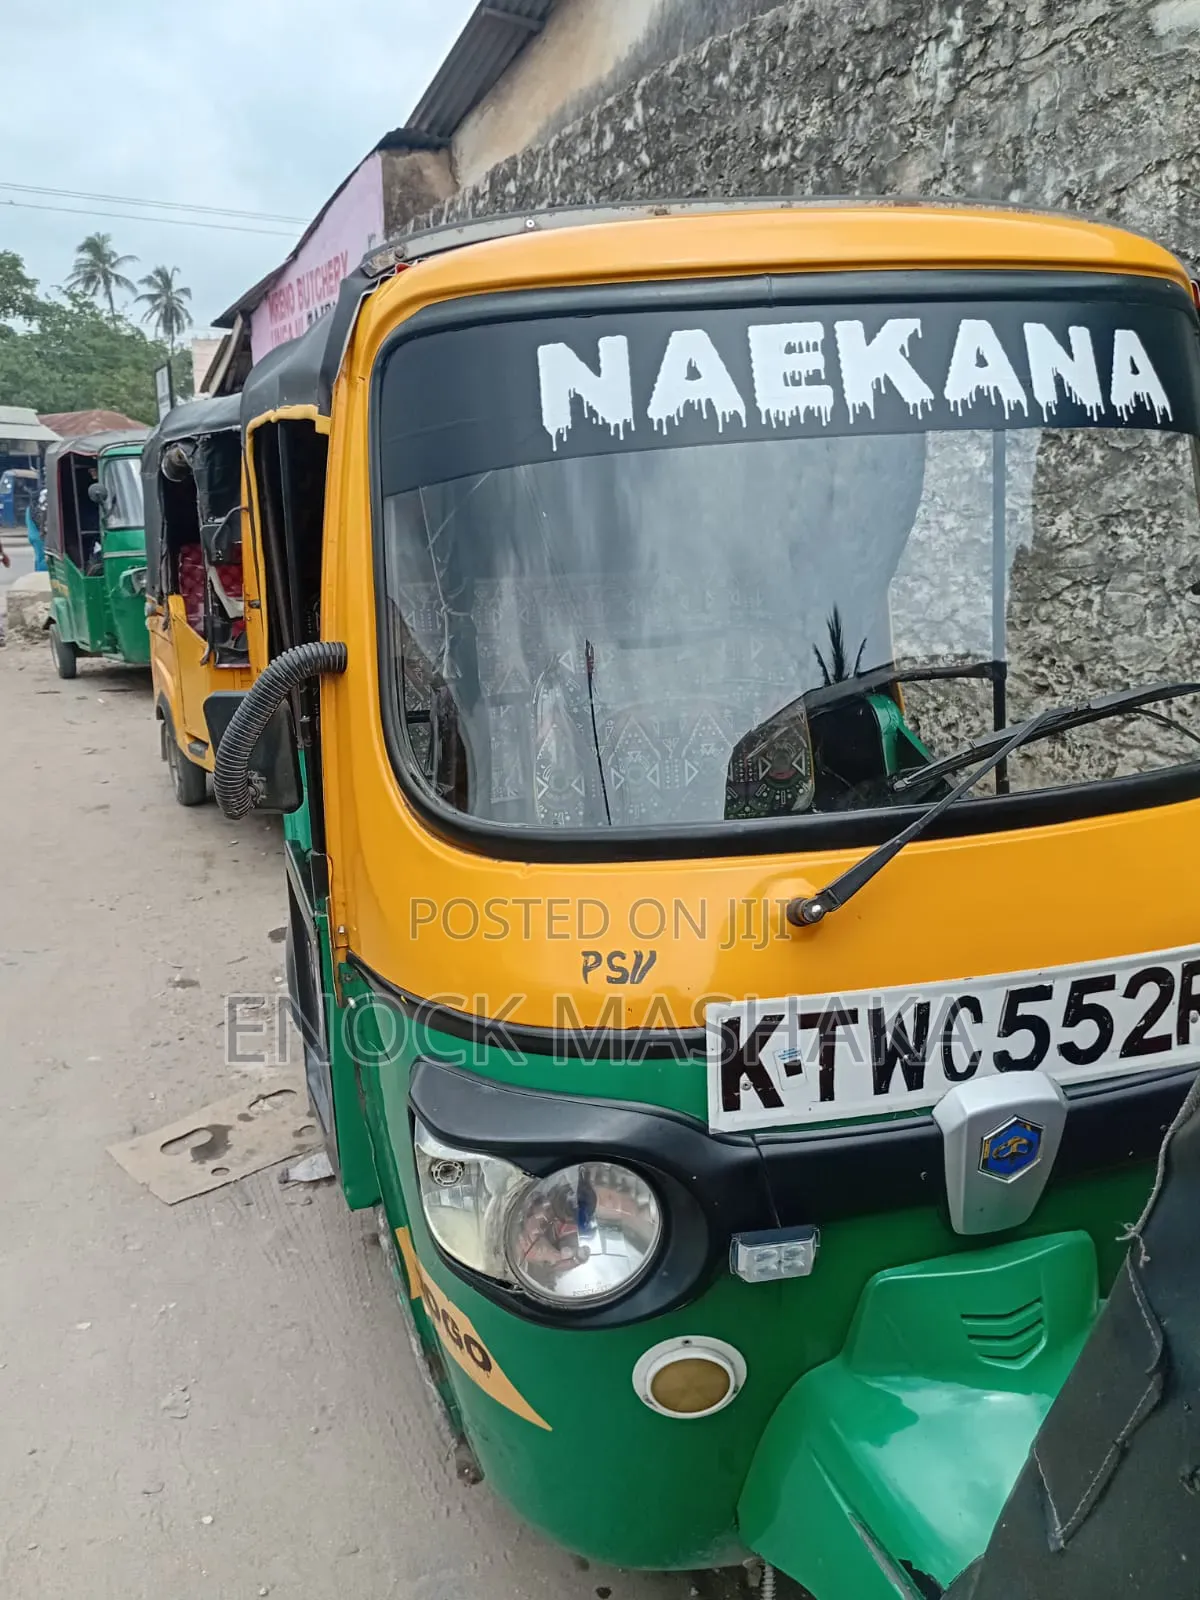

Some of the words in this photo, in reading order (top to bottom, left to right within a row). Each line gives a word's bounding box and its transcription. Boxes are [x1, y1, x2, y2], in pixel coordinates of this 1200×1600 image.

[296, 249, 348, 312] BUTCHERY
[537, 318, 1172, 452] NAEKANA
[581, 950, 657, 985] PSV
